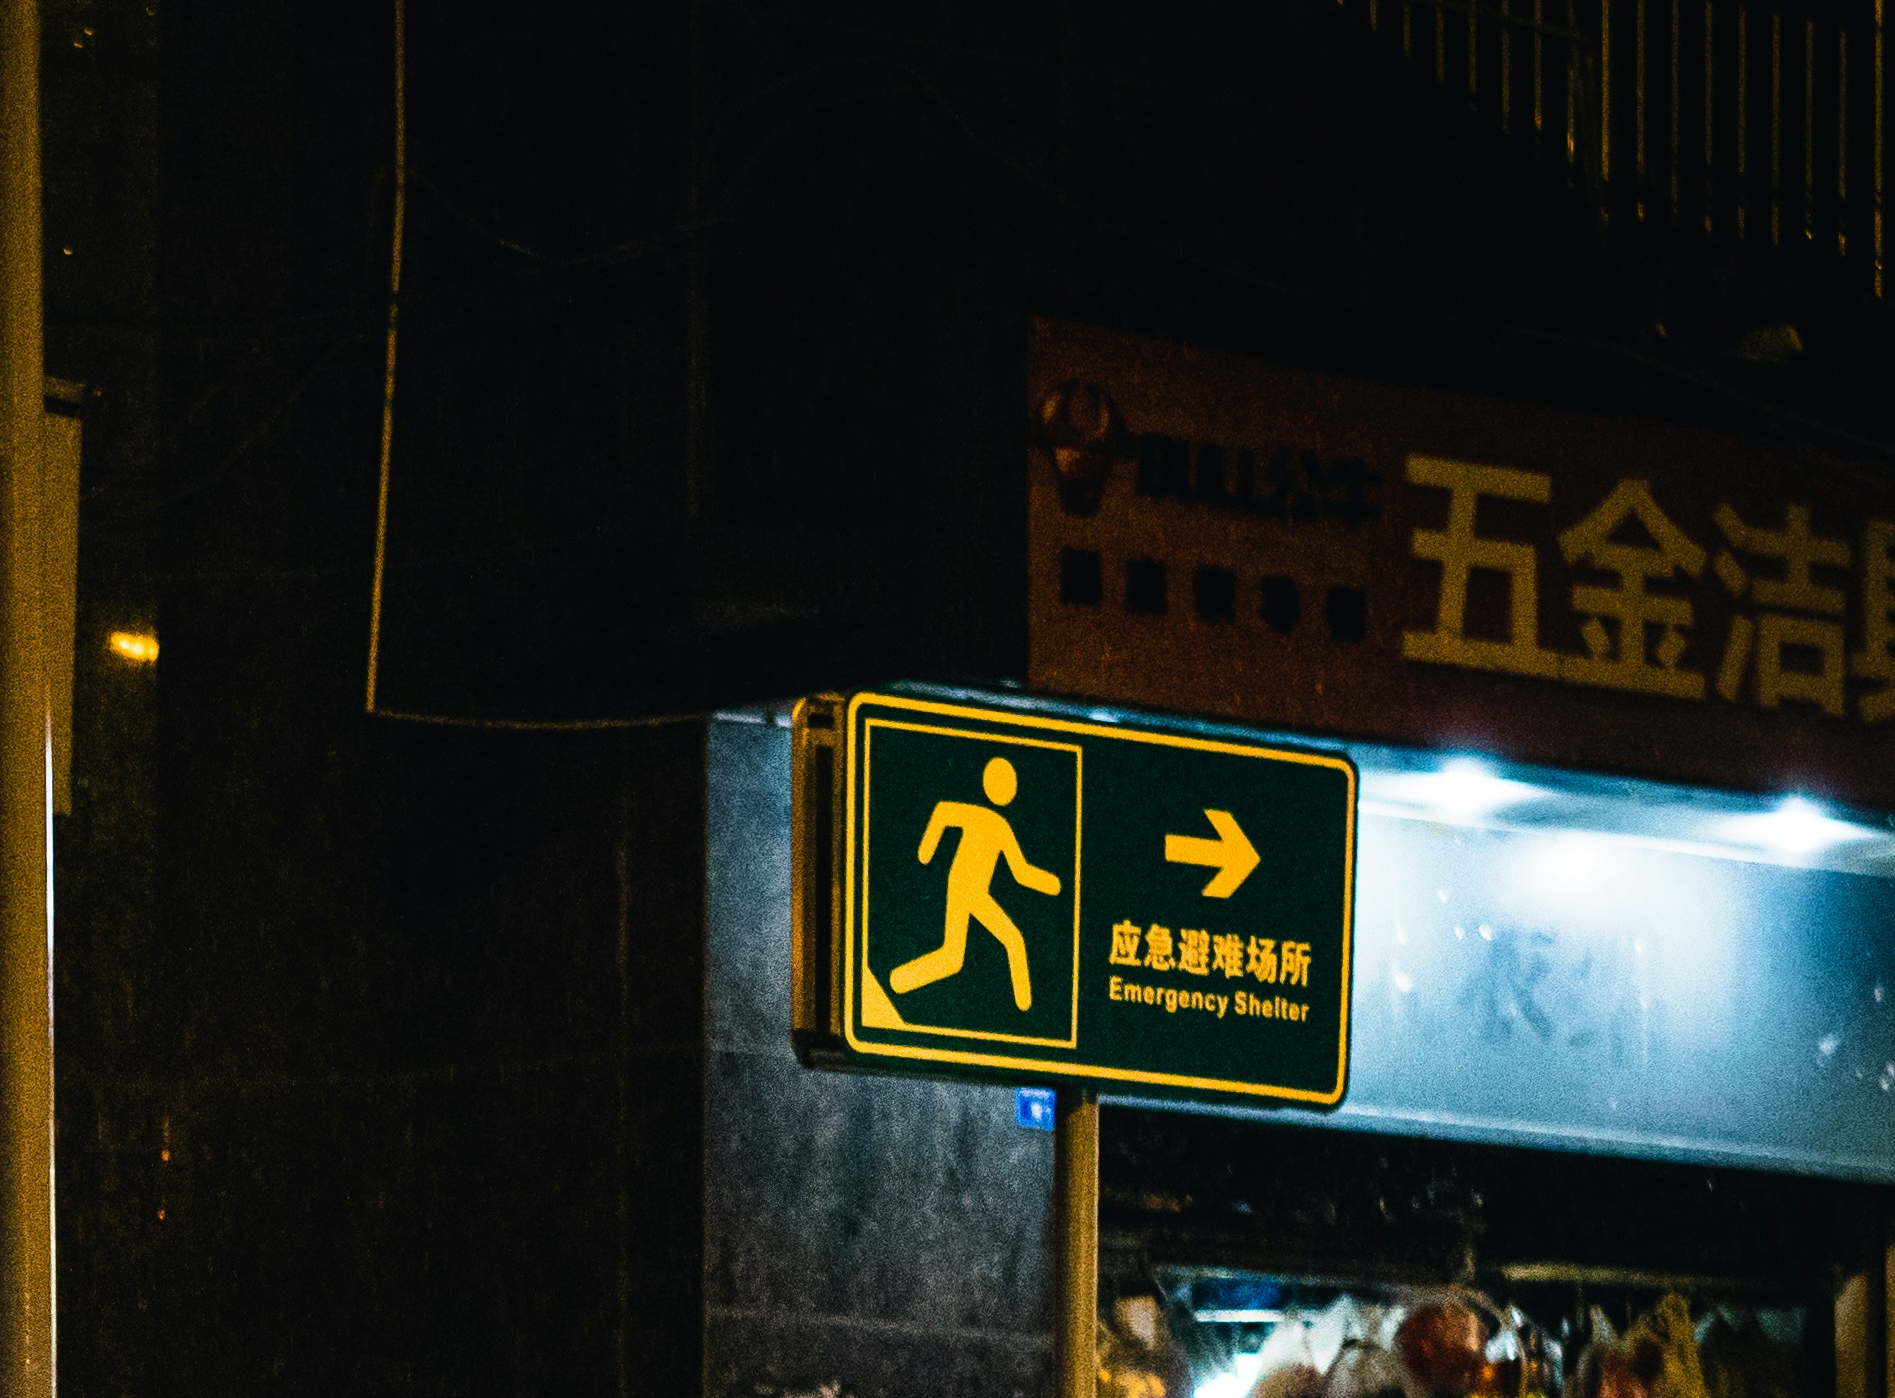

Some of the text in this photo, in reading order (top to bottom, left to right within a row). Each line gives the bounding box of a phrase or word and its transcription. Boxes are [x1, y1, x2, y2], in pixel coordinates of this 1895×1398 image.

[1401, 453, 1895, 725] 五金洁
[1109, 919, 1311, 986] 应急避难场所
[1109, 975, 1309, 1021] Emergency Shelter
